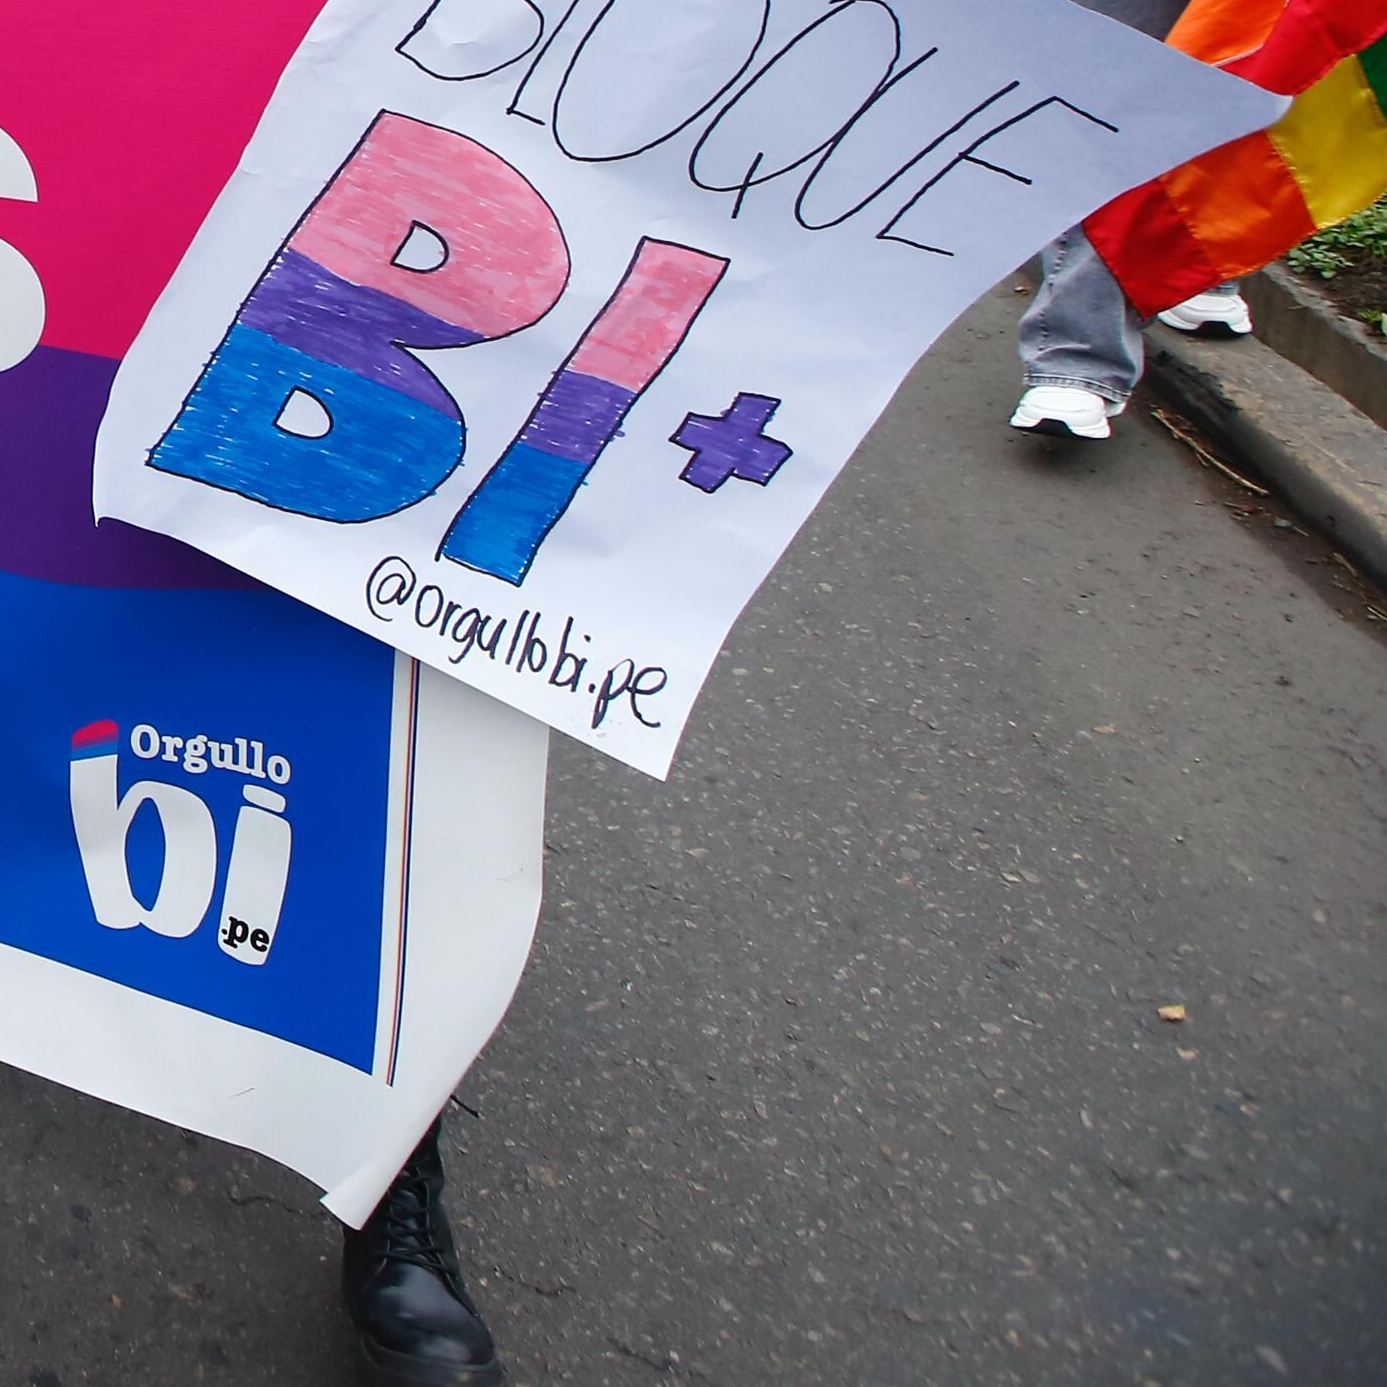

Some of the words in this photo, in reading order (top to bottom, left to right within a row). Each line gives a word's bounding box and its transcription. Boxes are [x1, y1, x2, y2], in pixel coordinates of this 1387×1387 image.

[130, 723, 292, 785] Orgullo
[70, 718, 292, 966] bi
[221, 915, 270, 953] .pe
